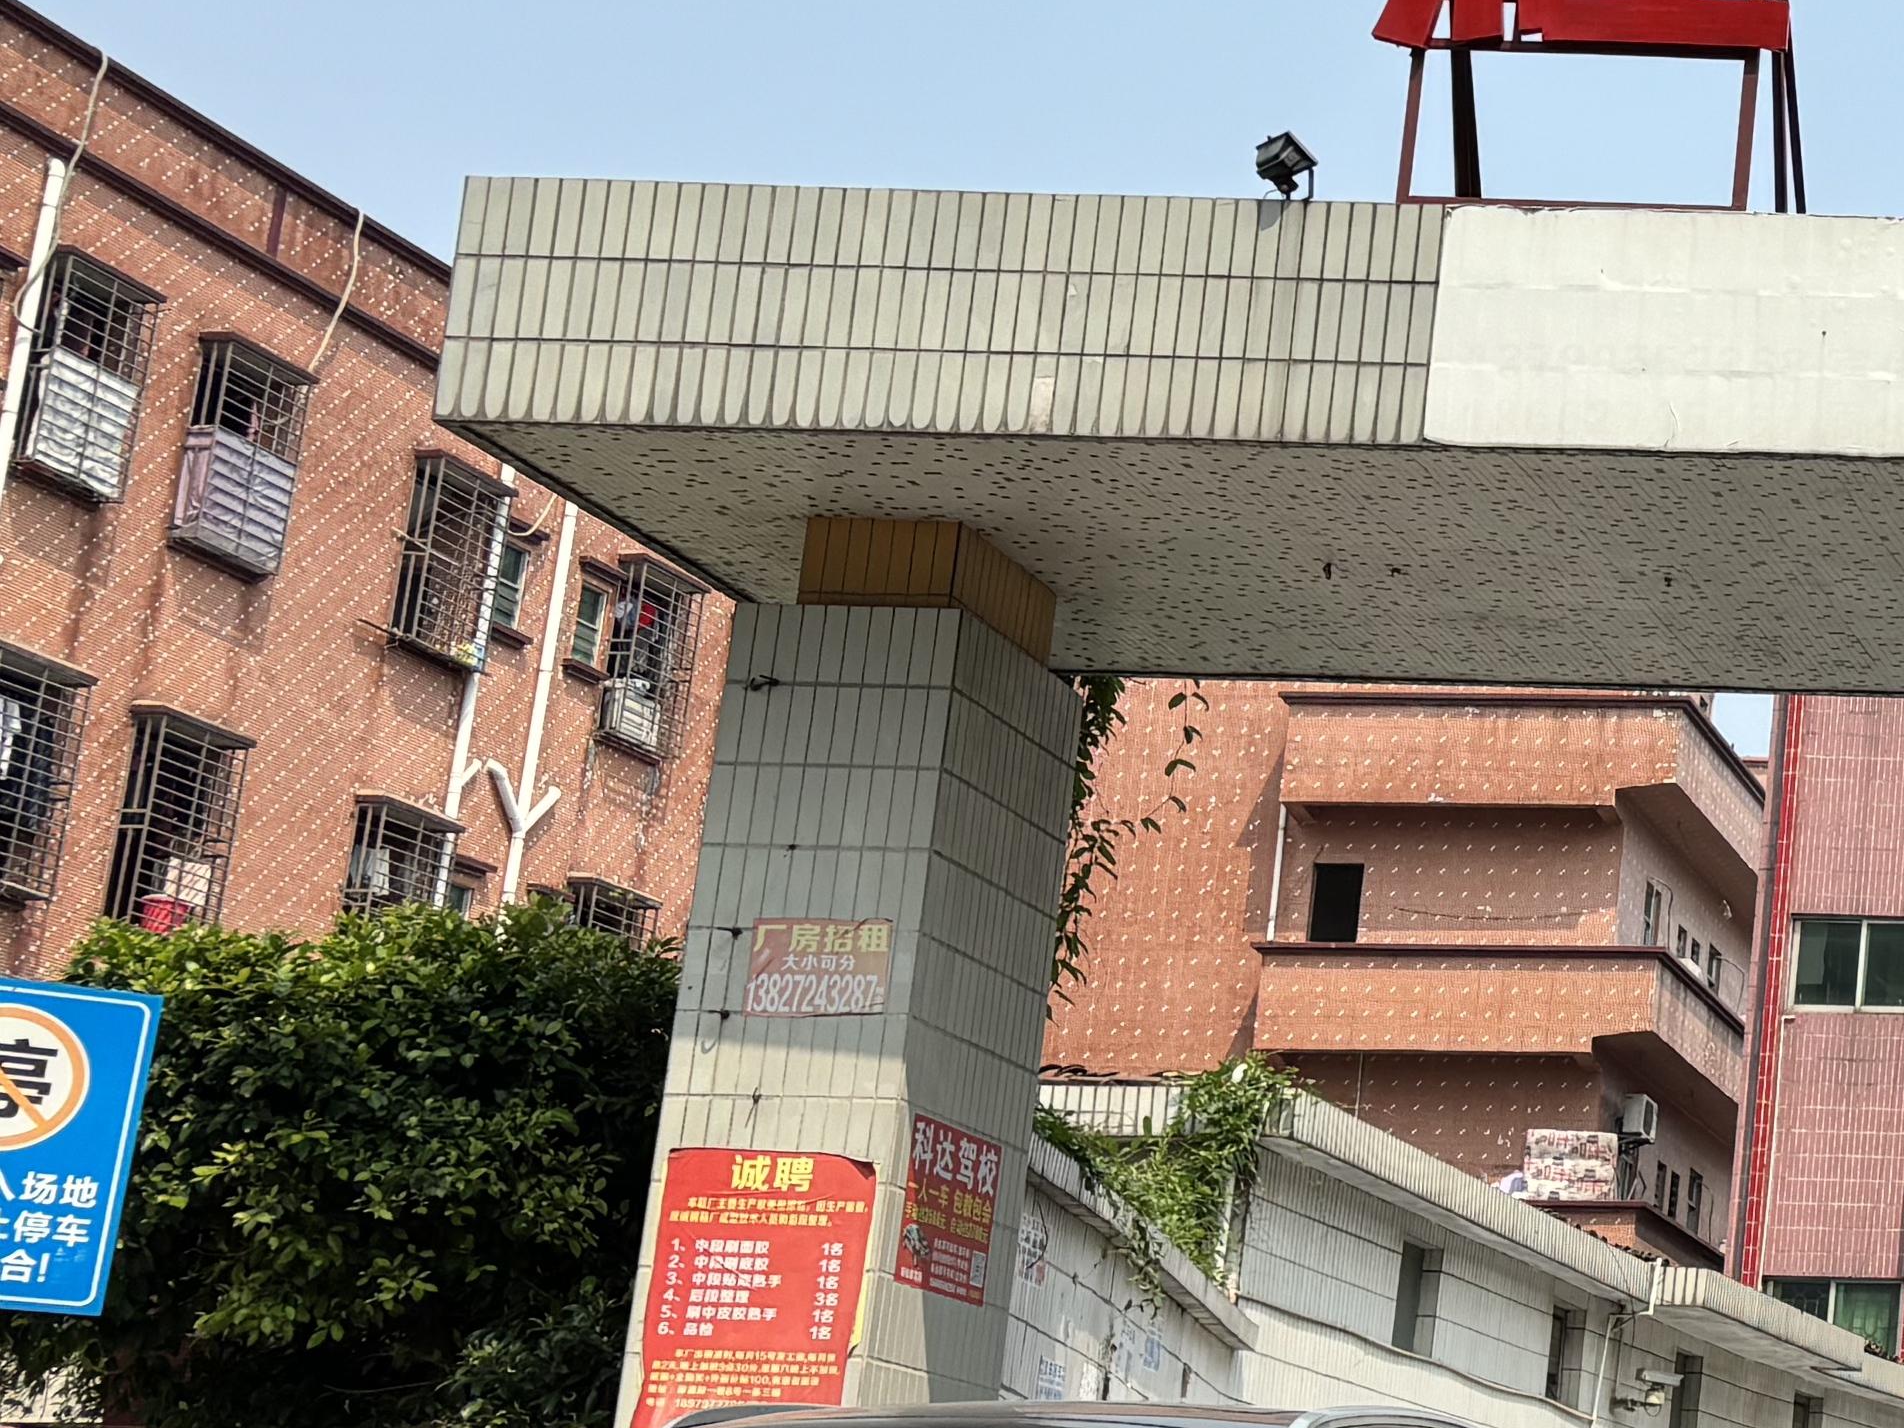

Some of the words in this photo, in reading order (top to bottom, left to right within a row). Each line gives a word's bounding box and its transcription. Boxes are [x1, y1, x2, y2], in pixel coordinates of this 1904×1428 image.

[753, 923, 890, 953] 厂房招租
[780, 954, 856, 971] 大小可分
[746, 972, 878, 1013] 13827243287
[912, 1122, 998, 1197] 科达驾校
[731, 1155, 814, 1192] 诚聘
[908, 1178, 950, 1209] 一人一车
[953, 1188, 992, 1224] 包教包会
[821, 1242, 843, 1256] 1名
[818, 1259, 841, 1273] 1名
[816, 1275, 839, 1290] 1名
[814, 1292, 839, 1307] 3名
[812, 1308, 834, 1323] 1名
[809, 1325, 832, 1340] 1名
